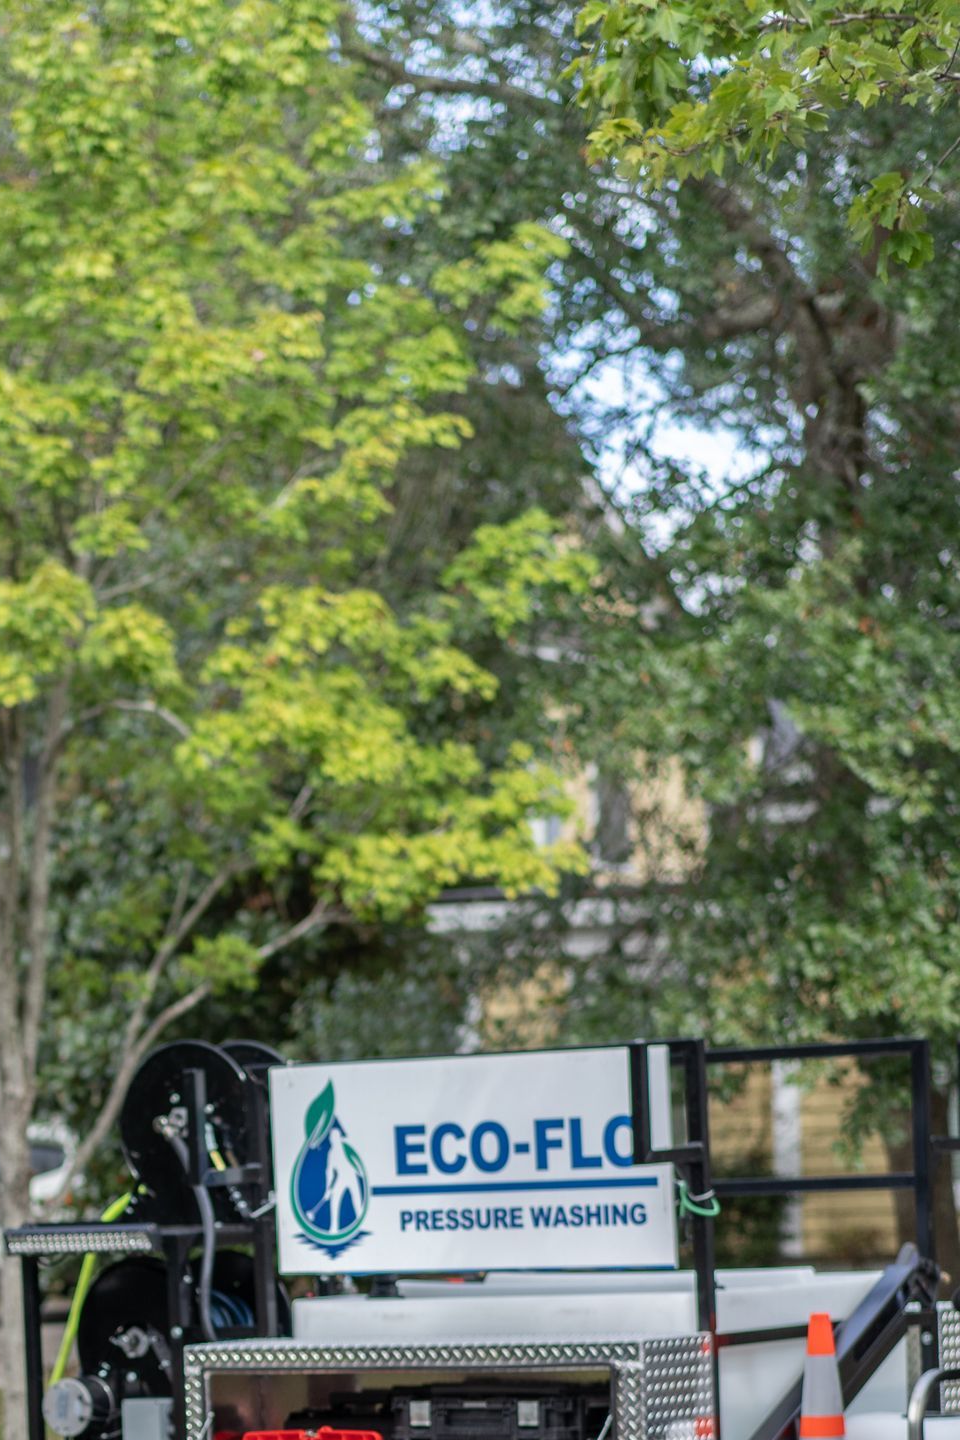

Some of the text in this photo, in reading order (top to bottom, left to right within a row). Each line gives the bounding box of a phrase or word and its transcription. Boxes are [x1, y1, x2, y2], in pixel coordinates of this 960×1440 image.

[393, 1114, 633, 1176] ECO-FLO
[400, 1203, 648, 1232] PRESSURE WASHING
